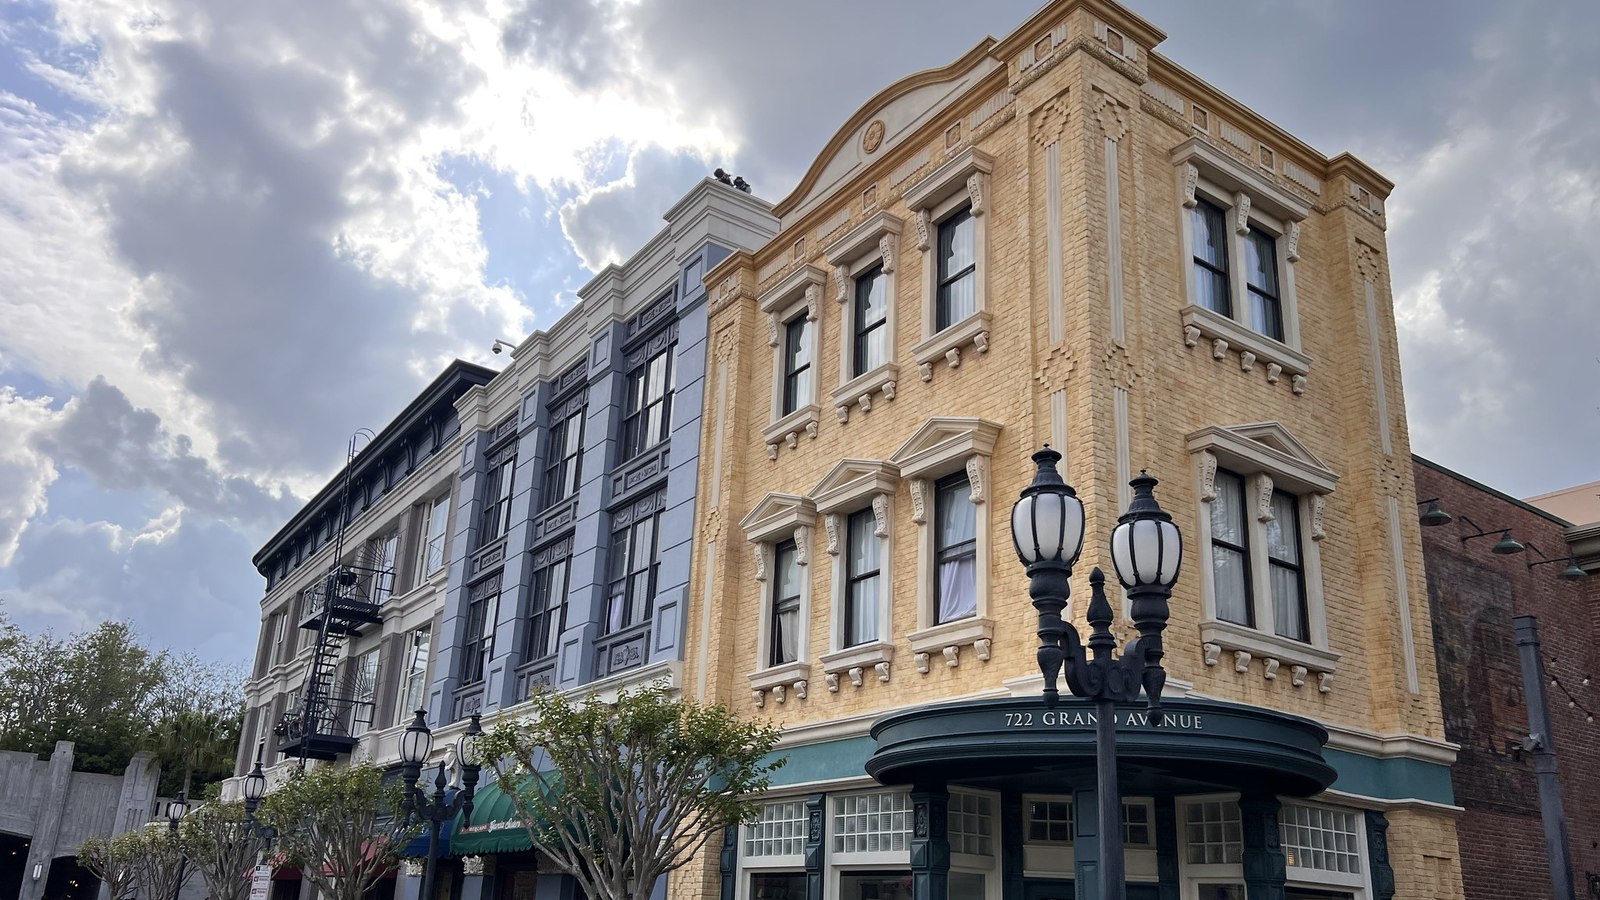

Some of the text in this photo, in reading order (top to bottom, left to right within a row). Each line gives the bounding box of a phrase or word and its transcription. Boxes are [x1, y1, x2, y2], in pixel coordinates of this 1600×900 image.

[1005, 711, 1203, 729] 722 GRAN AVNUE
